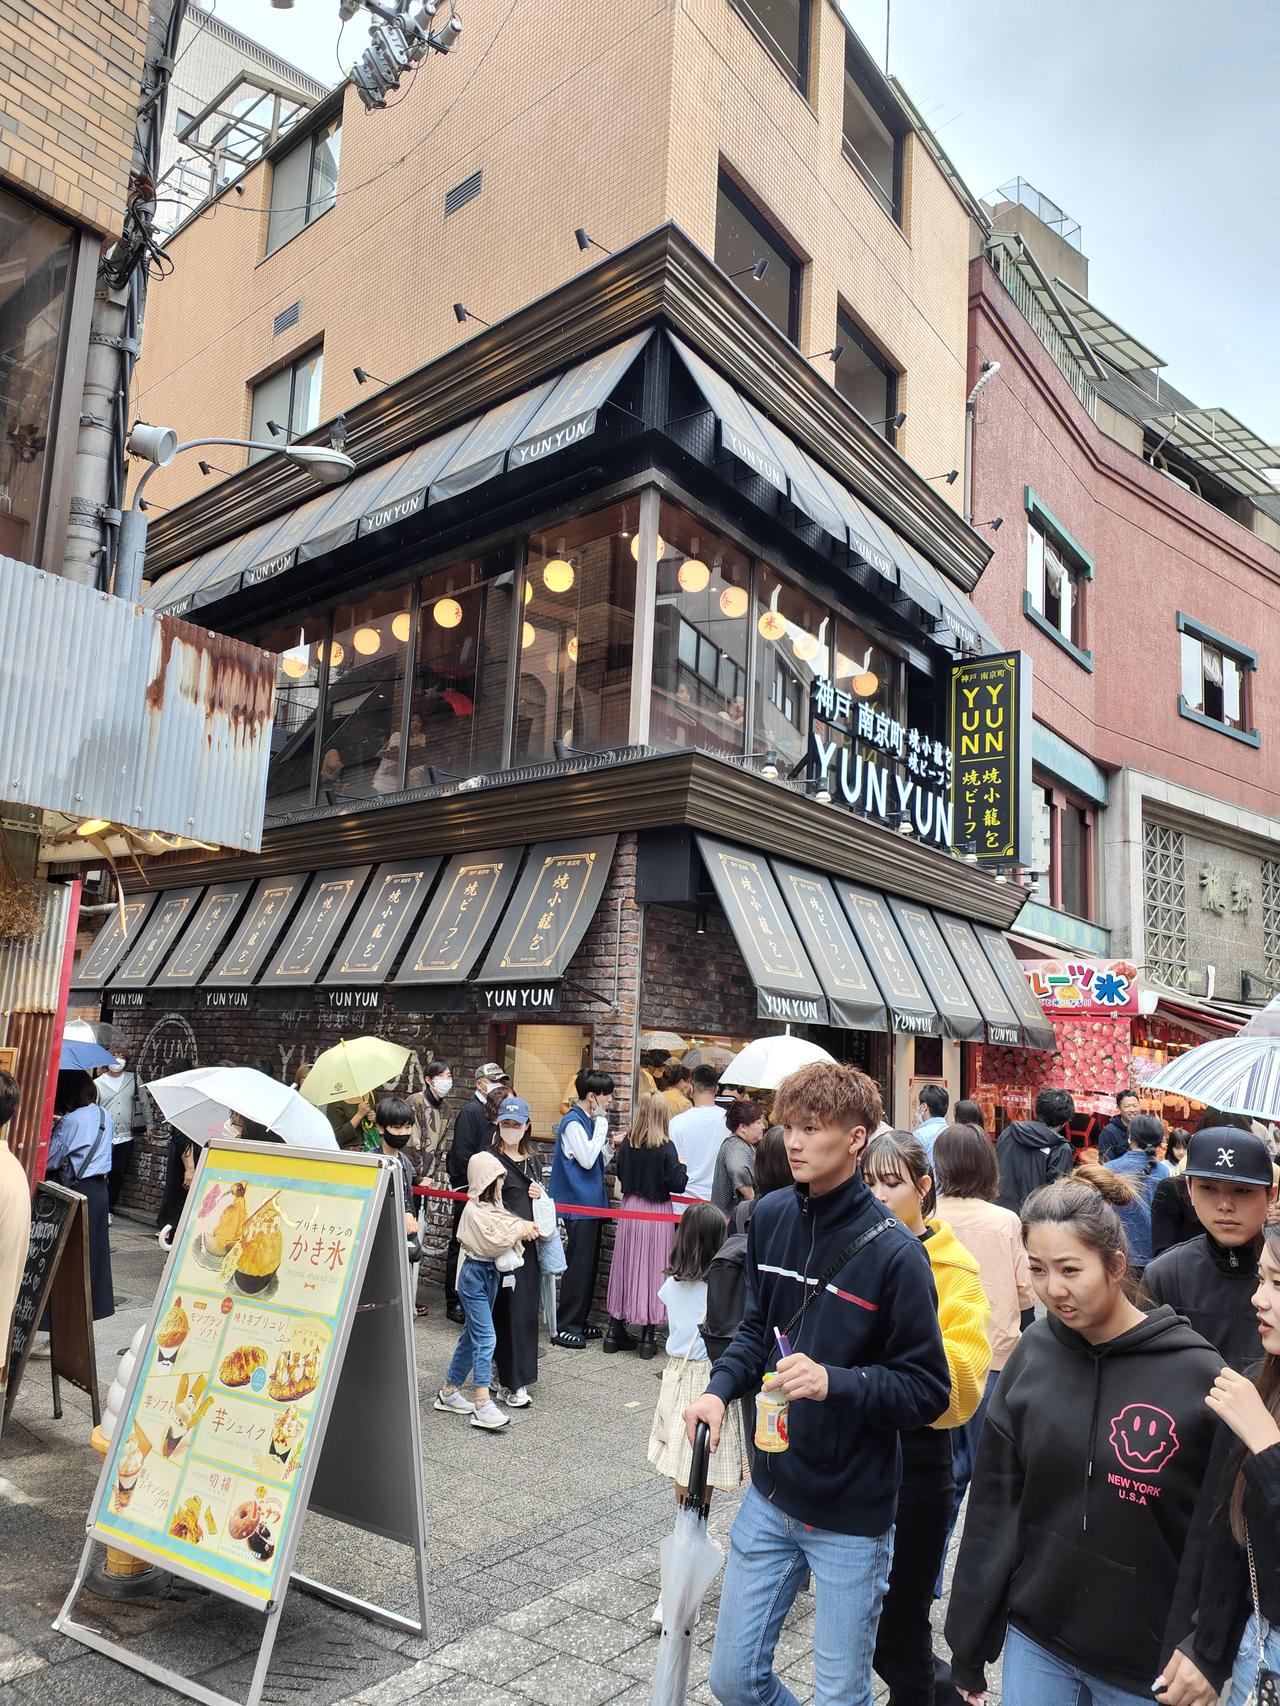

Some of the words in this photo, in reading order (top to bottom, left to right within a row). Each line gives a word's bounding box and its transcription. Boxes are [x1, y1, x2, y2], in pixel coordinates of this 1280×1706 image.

[520, 437, 552, 462] YUN
[555, 420, 587, 447] YUN
[730, 432, 756, 465] YUN
[756, 454, 781, 486] YUN
[368, 510, 393, 530] YUN
[394, 496, 419, 519] YUN
[250, 565, 269, 582] YUN
[270, 556, 292, 573] YUN
[945, 612, 960, 635] YUN
[960, 624, 975, 646] YUN
[815, 676, 852, 722] 神戸
[857, 701, 906, 758] 南京町
[814, 733, 889, 818] YUN
[894, 774, 954, 847] YUN
[982, 767, 1002, 849] 焼小籠包
[439, 880, 480, 954] 焼ビーフン
[529, 872, 571, 951] 焼小籠包
[111, 993, 127, 1005] YUN
[127, 993, 144, 1005] YUN
[206, 993, 228, 1006] YUN
[228, 992, 248, 1006] YUN
[329, 992, 353, 1007] YUN
[355, 992, 379, 1007] YUN
[485, 989, 518, 1008] YUN
[520, 988, 554, 1006] YUN
[765, 995, 792, 1017] YUN
[792, 1000, 818, 1019] YUN
[894, 1014, 916, 1029] YUN
[915, 1017, 934, 1033] YUN
[990, 1027, 1005, 1042] YUN
[1004, 1030, 1018, 1043] YUN
[296, 1219, 353, 1238] ブリキトタンの
[288, 1235, 346, 1271] かき氷
[212, 1407, 266, 1441] 芋シェイク
[1107, 1472, 1130, 1488] NEW
[1132, 1480, 1161, 1497] YORK
[1119, 1489, 1147, 1506] U.S.A
